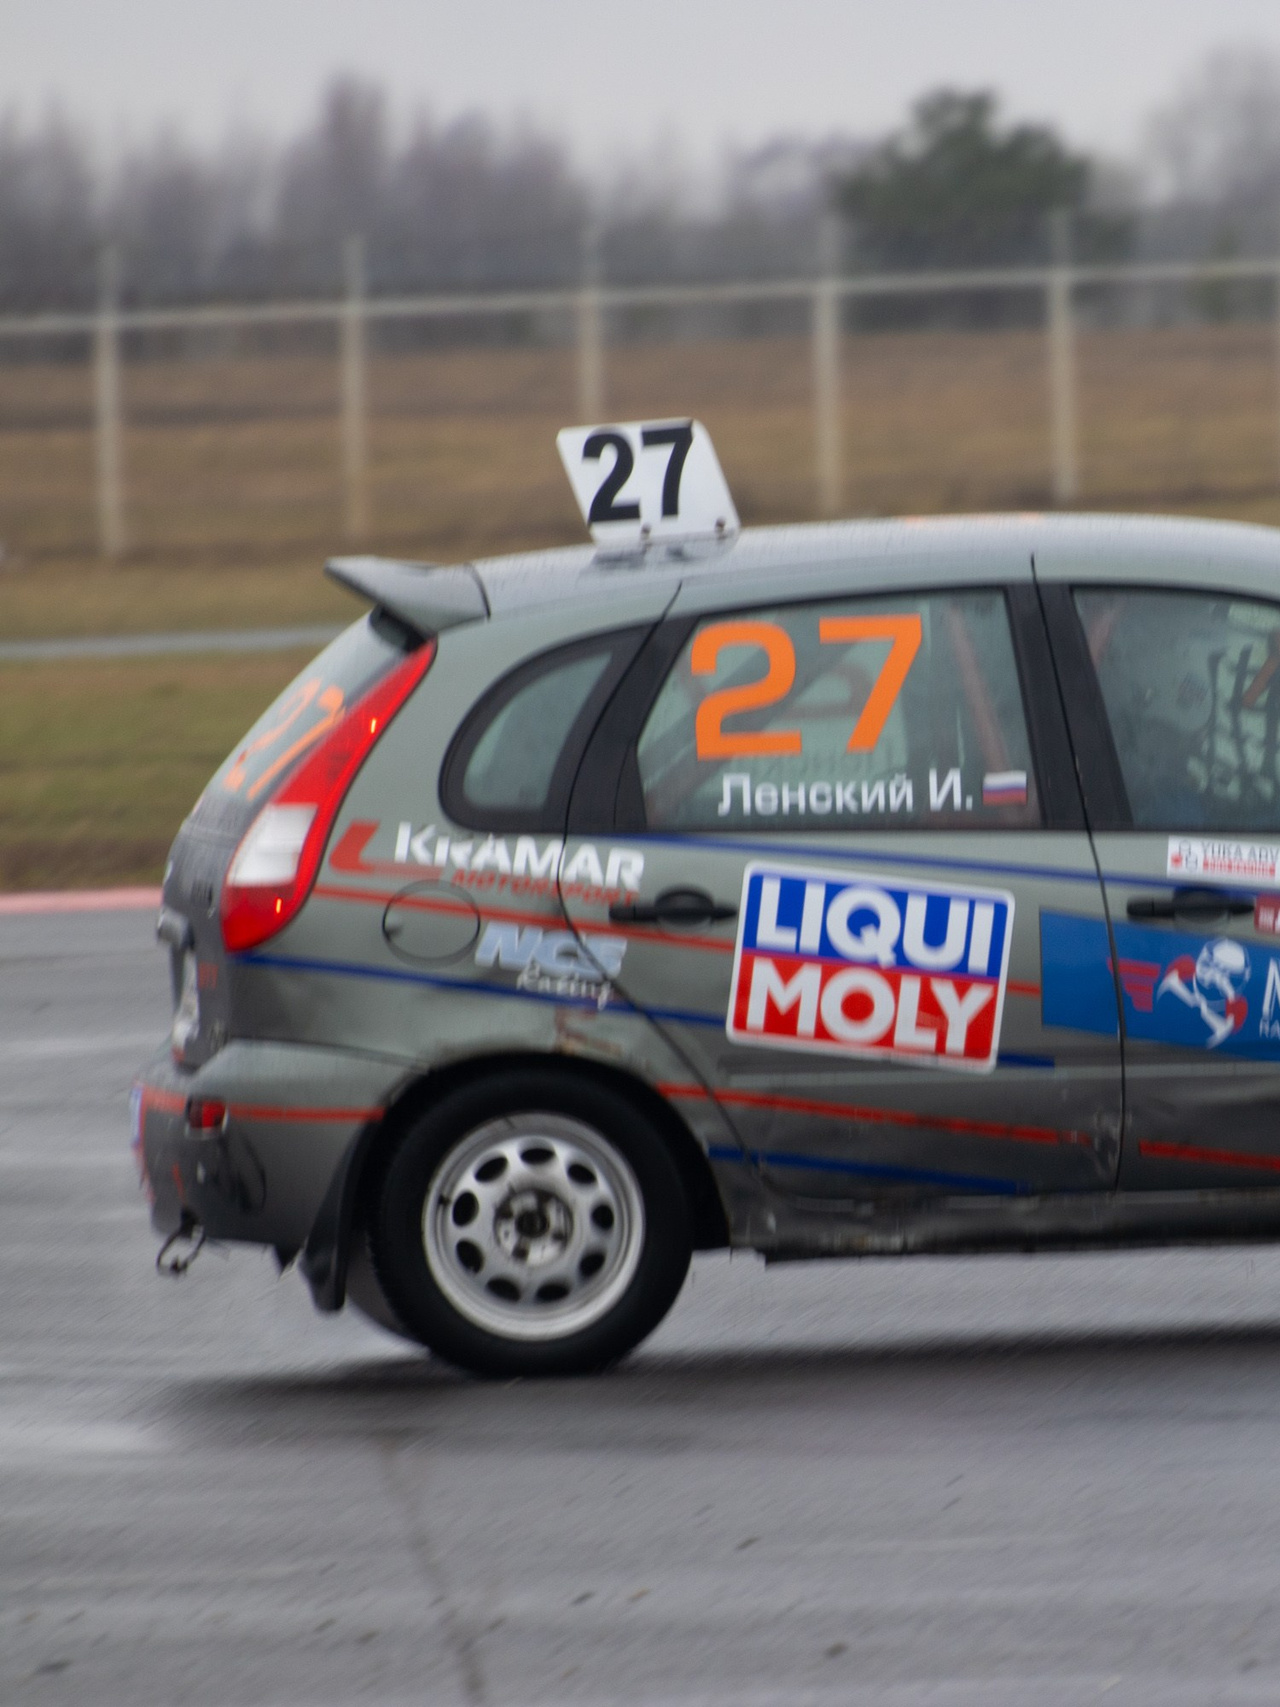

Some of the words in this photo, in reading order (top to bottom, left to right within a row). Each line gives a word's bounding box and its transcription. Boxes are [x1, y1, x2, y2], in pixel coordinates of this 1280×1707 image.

[581, 426, 694, 524] 27
[691, 613, 922, 760] 27
[717, 772, 914, 816] Ленский
[928, 766, 974, 813] И.
[394, 820, 645, 892] KRAMAR
[755, 876, 995, 976] LIQUI
[746, 956, 995, 1057] MOLY
